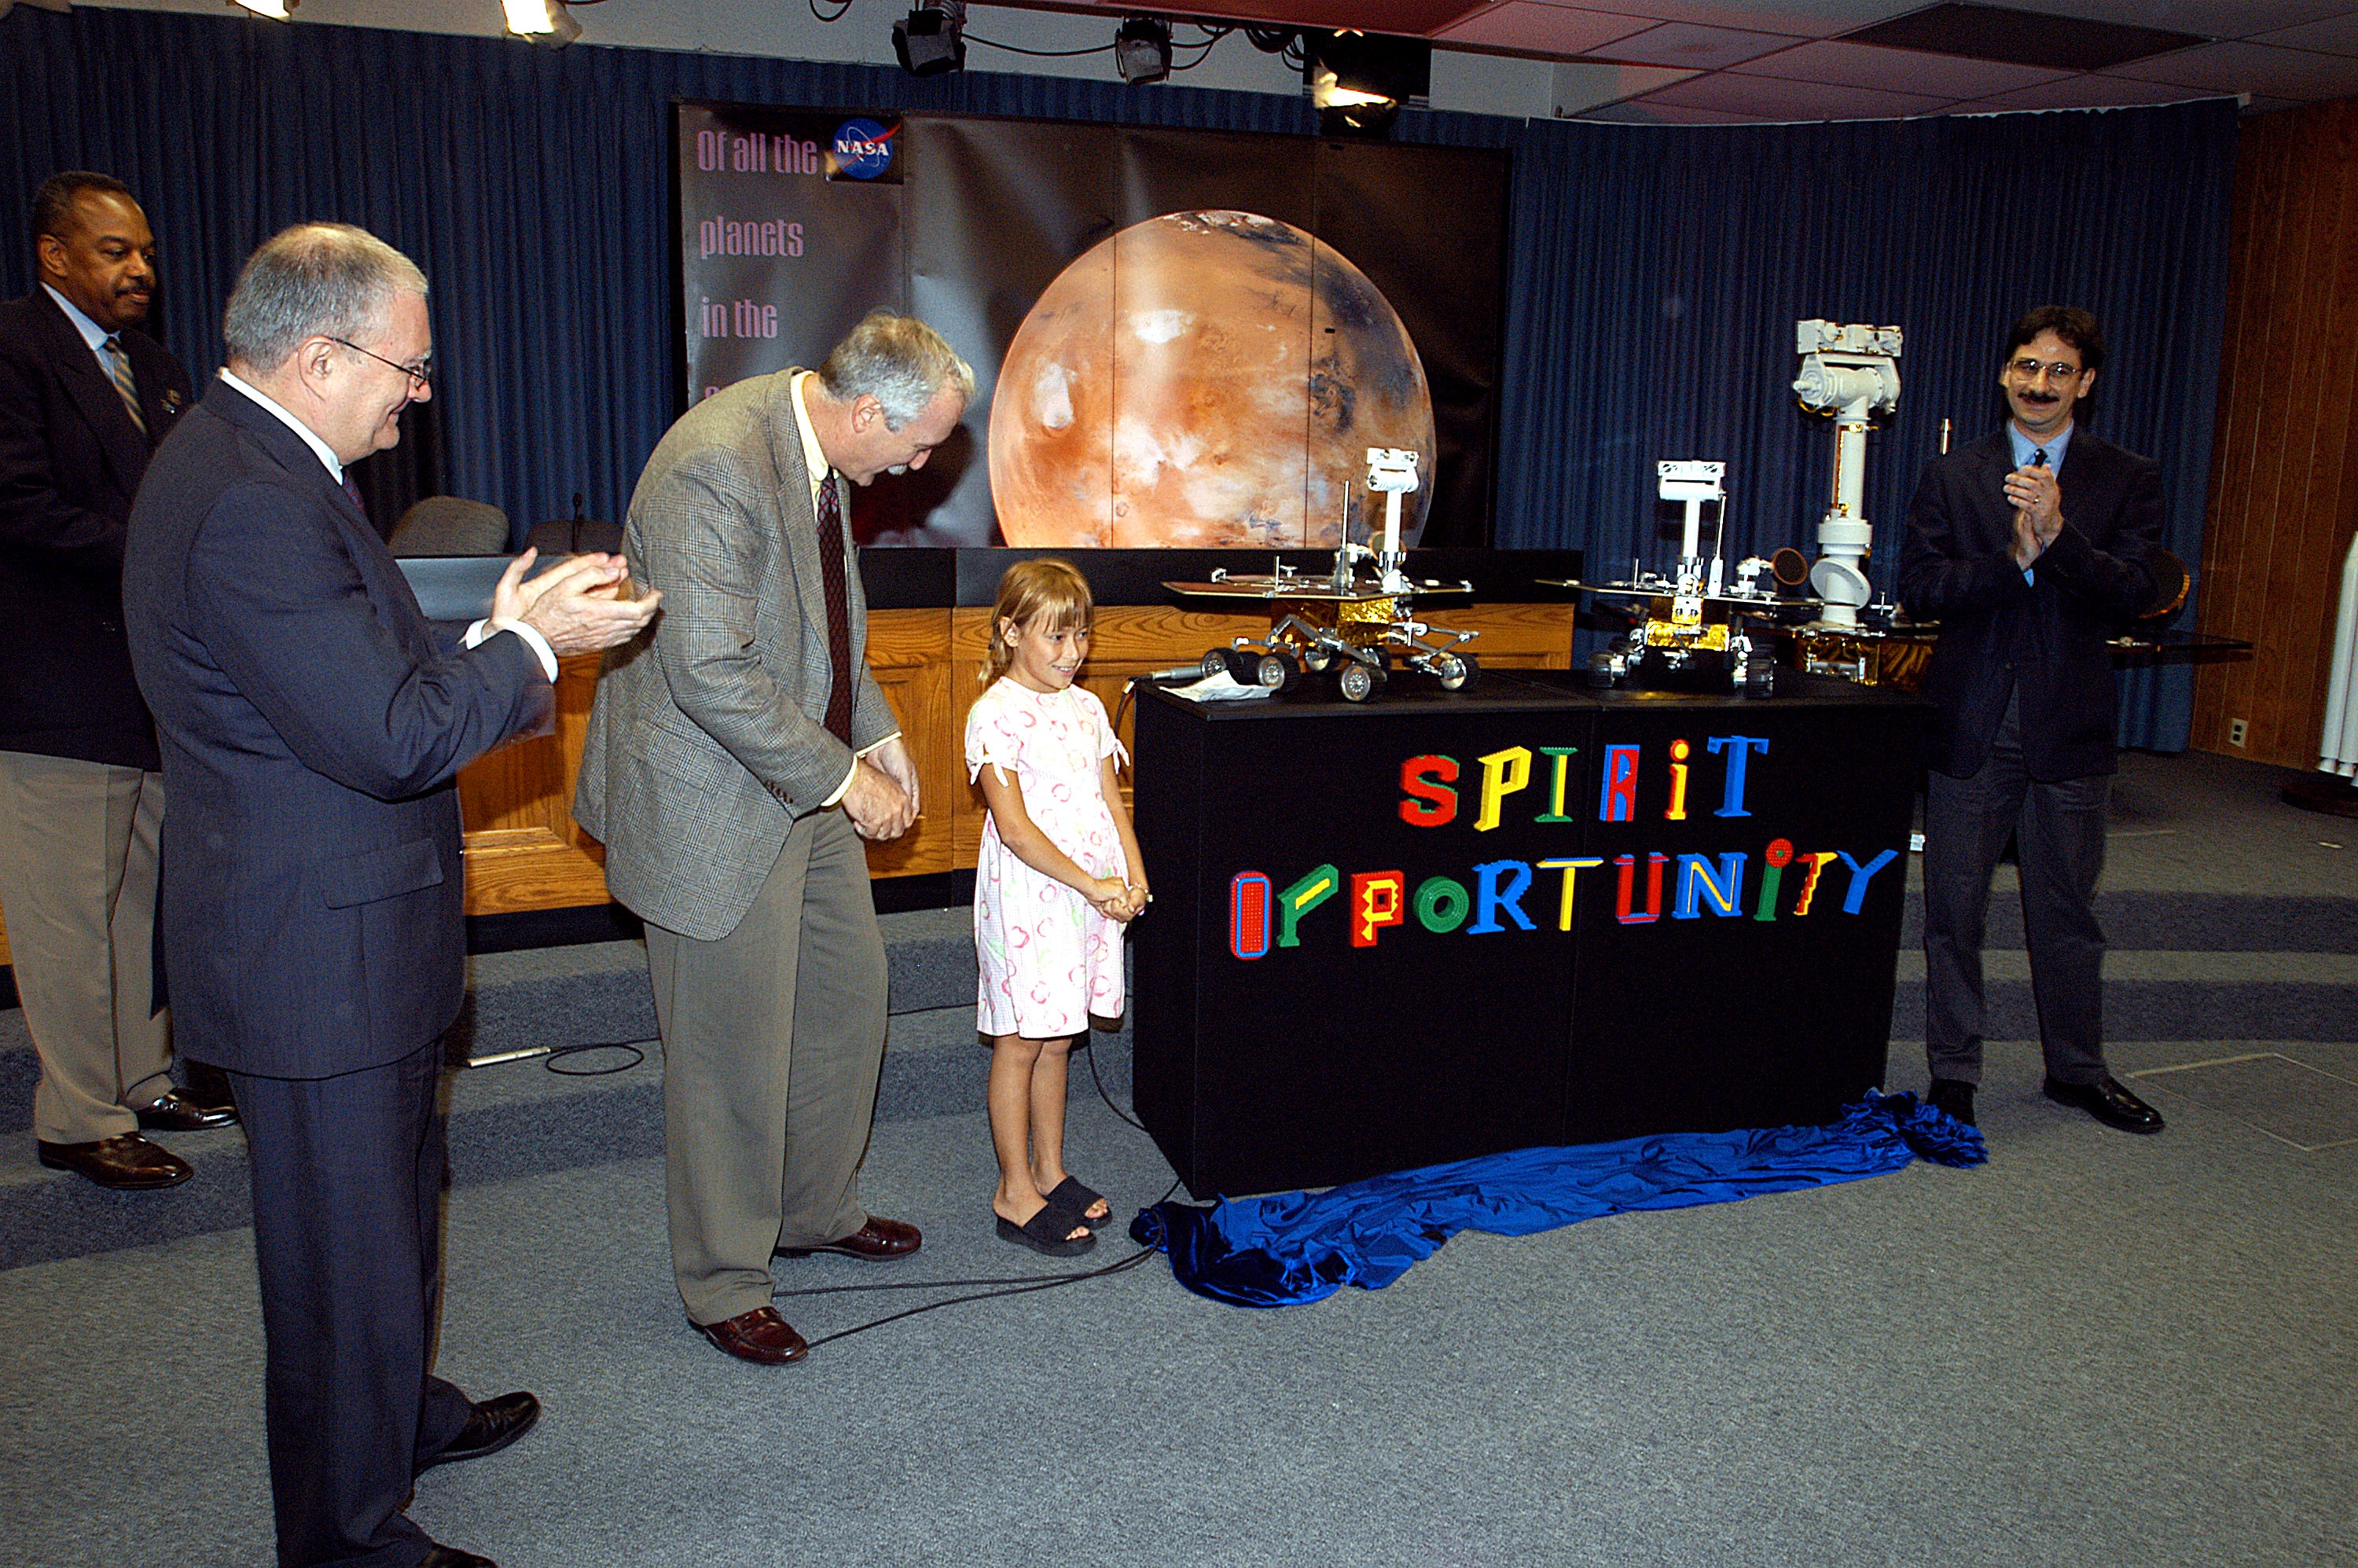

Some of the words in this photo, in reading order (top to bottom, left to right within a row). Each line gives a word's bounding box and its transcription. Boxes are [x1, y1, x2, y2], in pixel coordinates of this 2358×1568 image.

[697, 130, 728, 172] Of
[733, 133, 766, 172] all
[774, 134, 818, 175] the
[836, 139, 889, 156] NASA
[700, 215, 804, 259] planets
[702, 296, 728, 338] in
[735, 299, 778, 338] the
